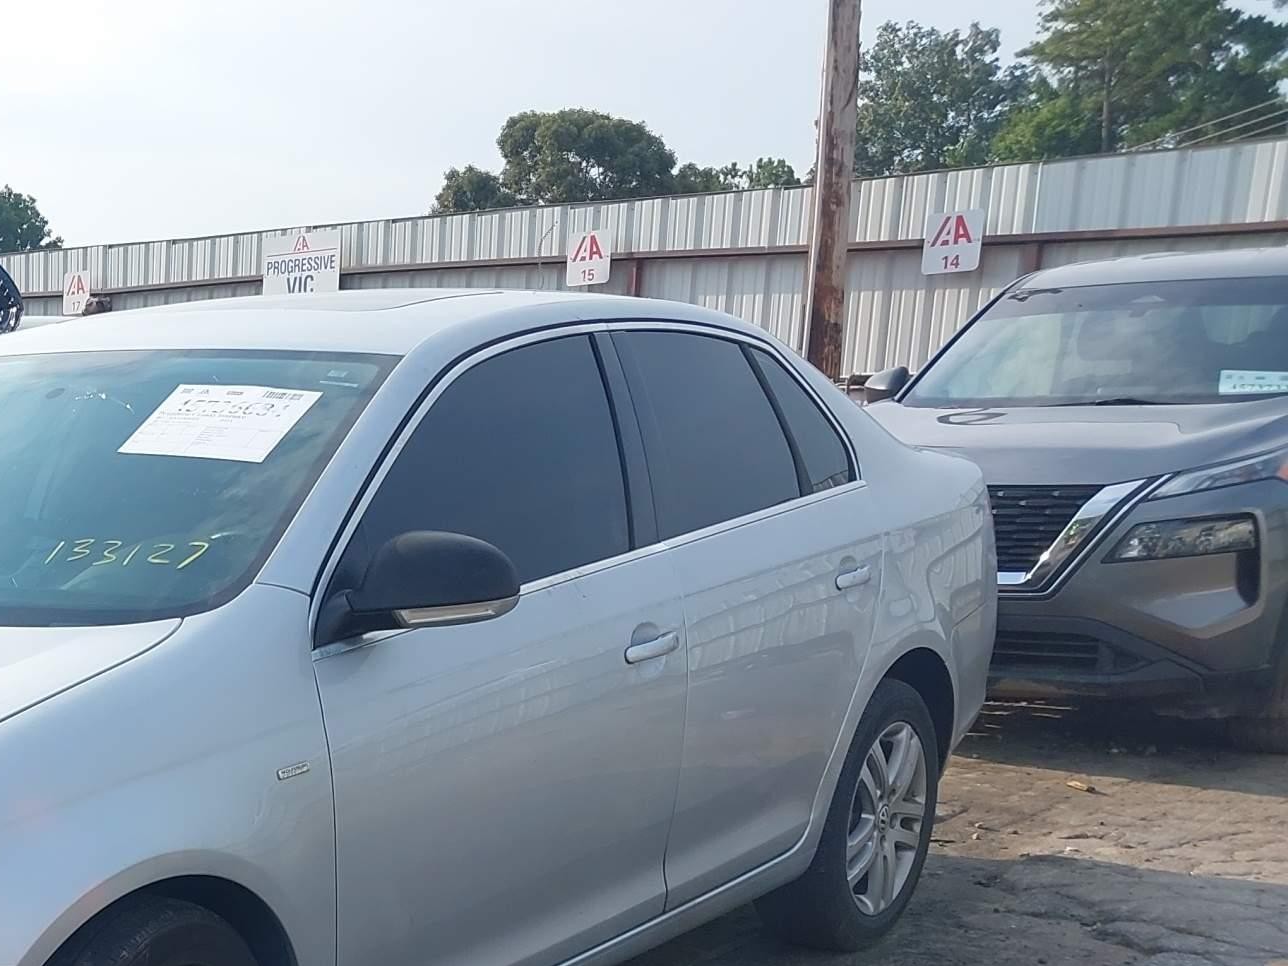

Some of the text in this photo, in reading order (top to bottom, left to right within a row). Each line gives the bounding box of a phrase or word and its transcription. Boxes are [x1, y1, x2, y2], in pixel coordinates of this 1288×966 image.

[267, 255, 336, 276] PROGRESSIVE
[942, 254, 960, 269] 14
[581, 268, 595, 282] 15
[72, 301, 81, 312] 17
[44, 538, 210, 569] 133127
